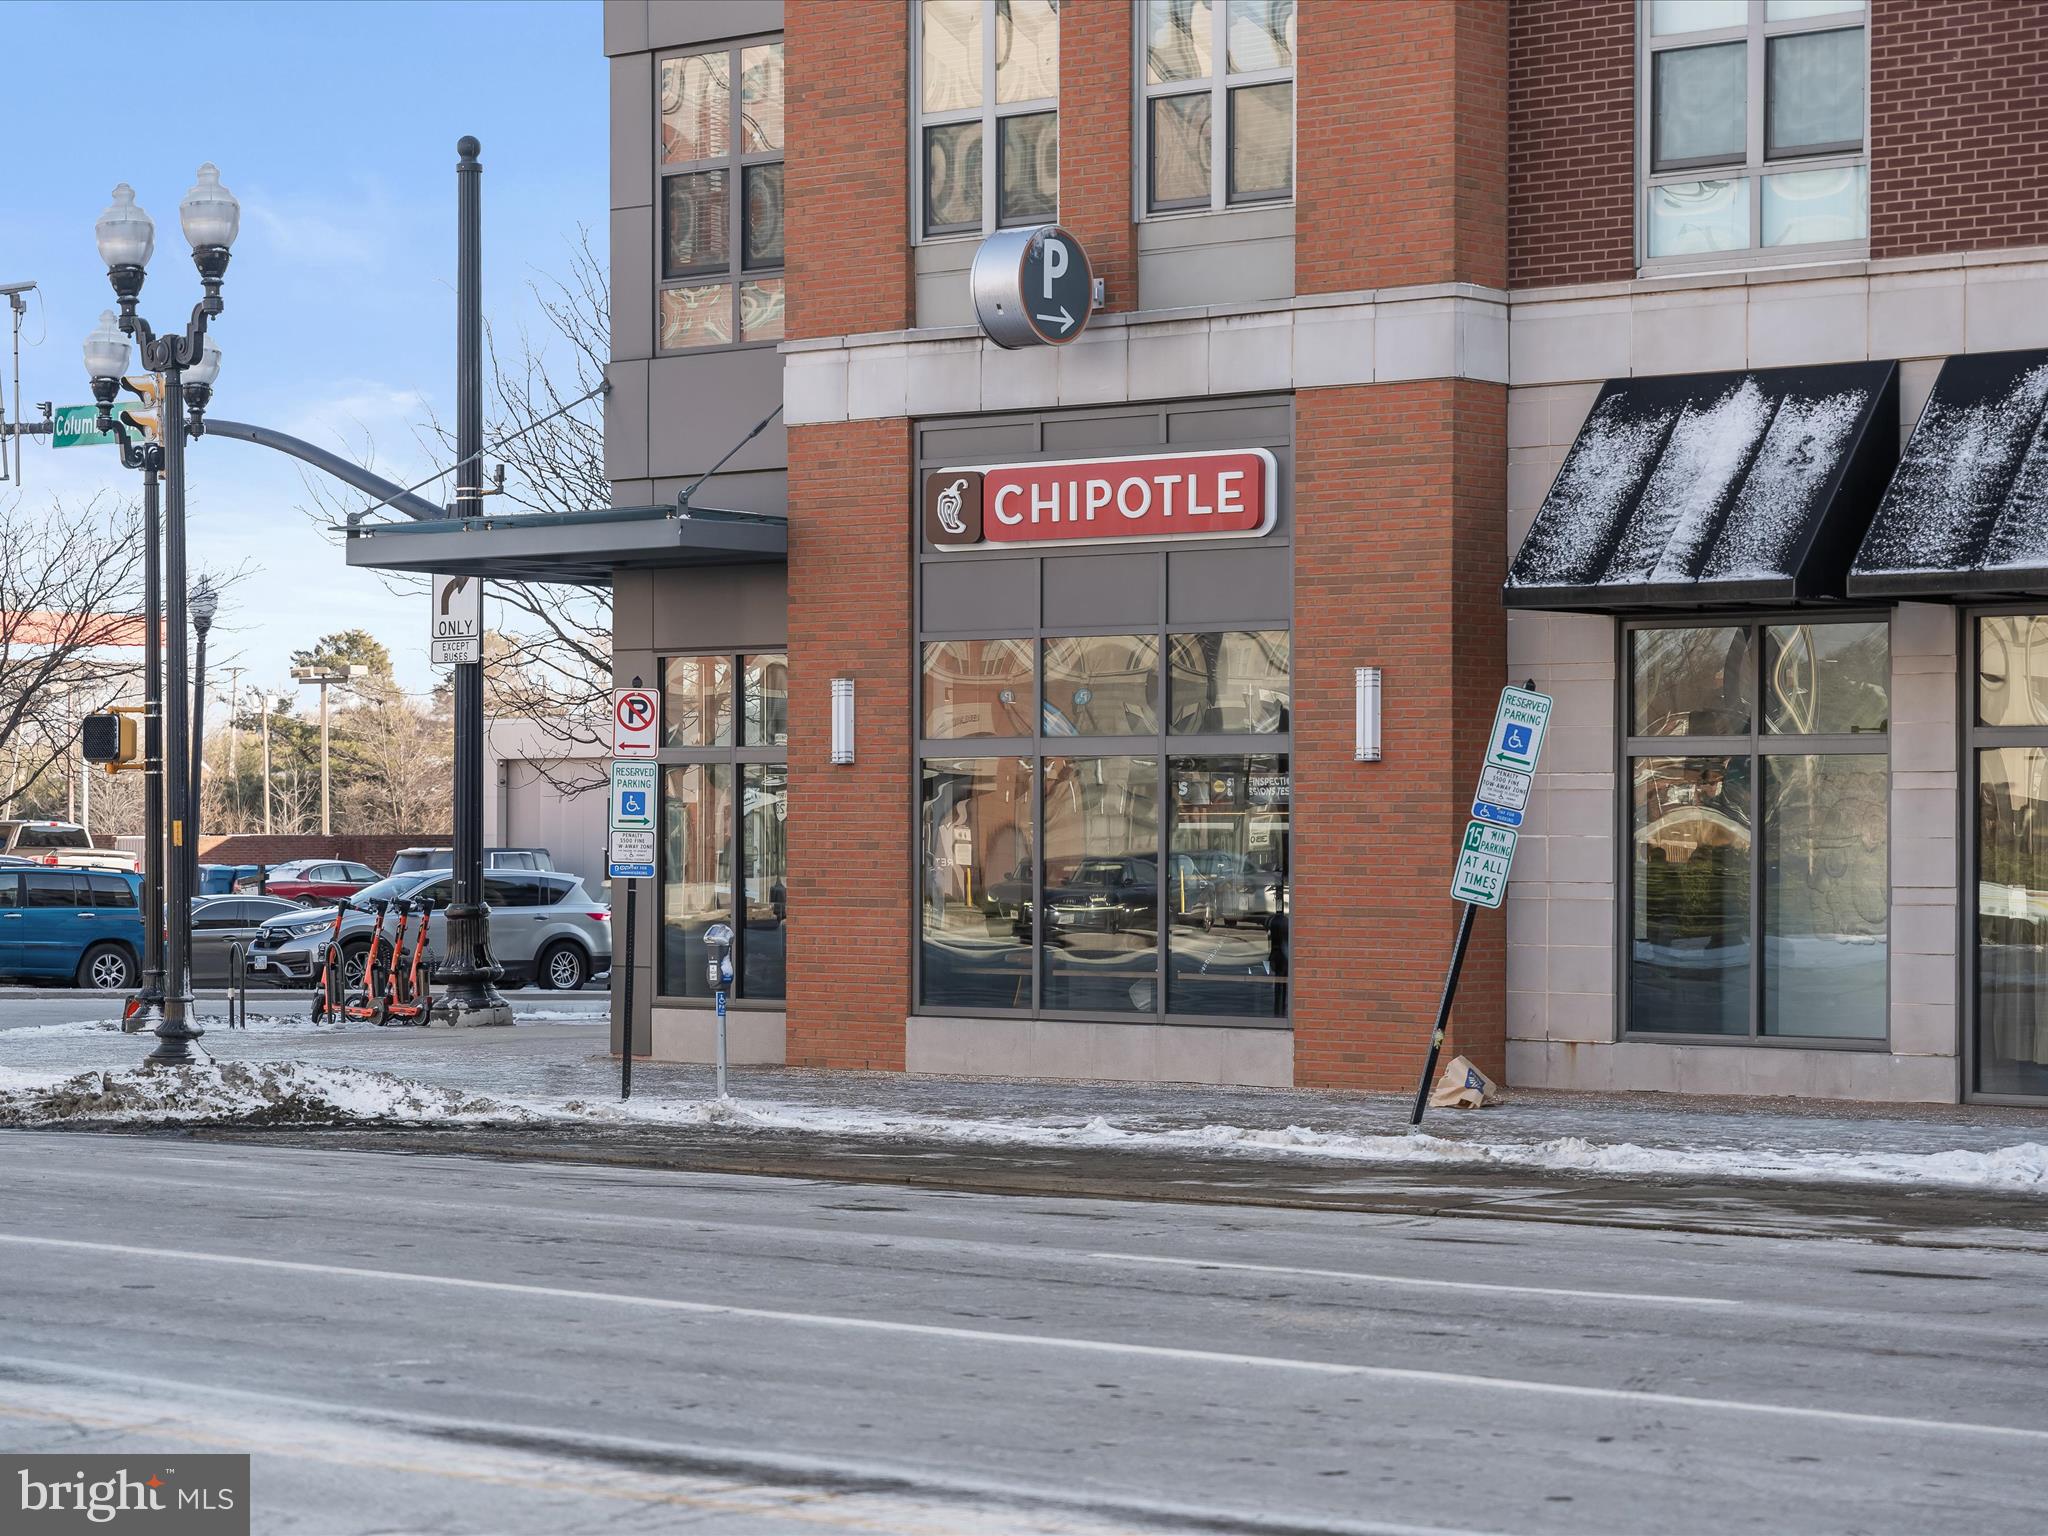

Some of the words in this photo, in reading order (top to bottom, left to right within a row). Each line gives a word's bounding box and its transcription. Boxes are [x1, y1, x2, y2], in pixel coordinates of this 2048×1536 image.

[1043, 238, 1069, 299] P
[994, 470, 1245, 526] CHIPOTLE
[439, 620, 472, 636] ONLY
[442, 642, 469, 651] EXCEPT
[444, 652, 468, 661] BUSES
[1506, 695, 1548, 713] RESERVED
[1504, 708, 1541, 725] PARKING
[615, 767, 655, 777] RESERVED
[1496, 770, 1519, 780] PENALTY
[617, 779, 651, 788] PARKING
[1508, 779, 1520, 787] FINE
[1512, 787, 1527, 795] ZONE
[1469, 826, 1482, 847] 15
[1491, 830, 1507, 842] MIN
[1480, 841, 1511, 857] PARKING
[1464, 855, 1479, 868] AT
[1482, 859, 1503, 875] ALL
[1464, 871, 1497, 890] TIMES
